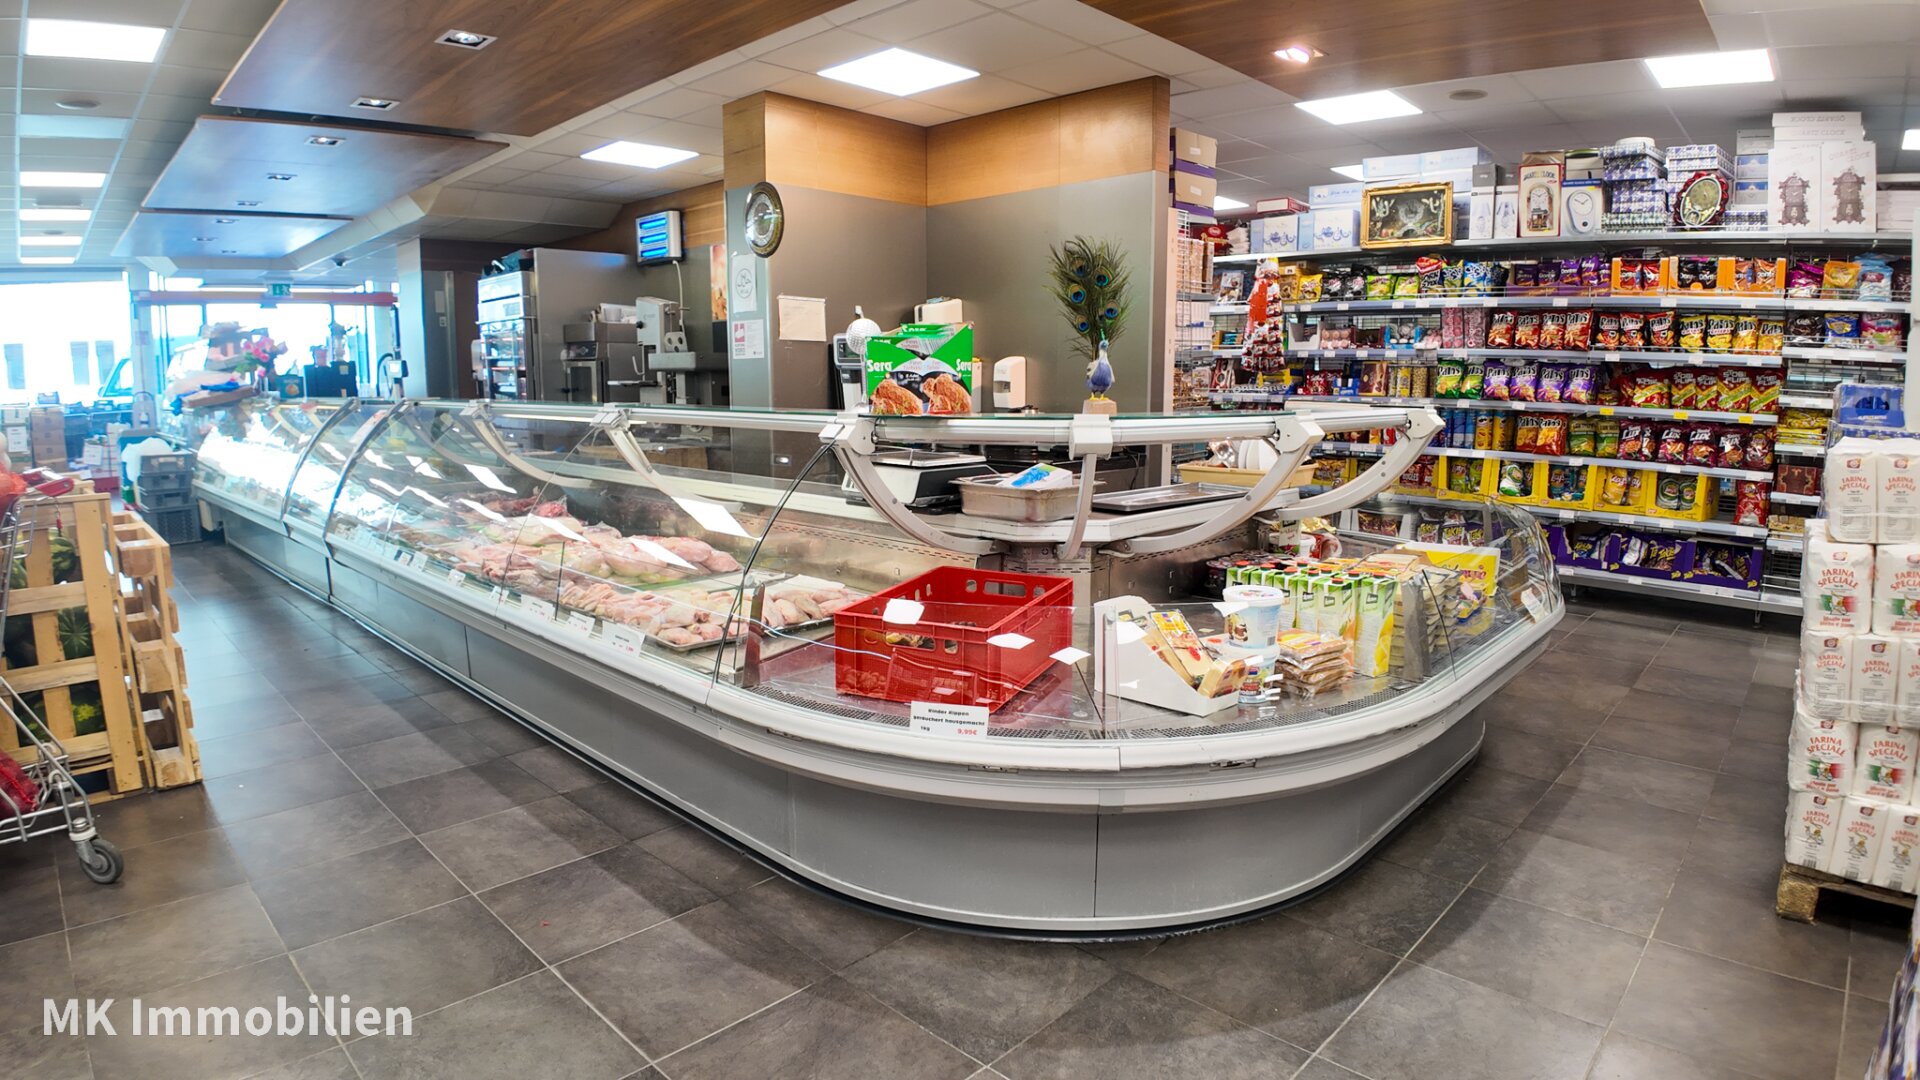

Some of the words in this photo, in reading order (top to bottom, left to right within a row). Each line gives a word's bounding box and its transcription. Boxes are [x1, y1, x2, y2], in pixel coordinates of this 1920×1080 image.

[867, 359, 893, 372] Sera
[1841, 476, 1868, 484] FARINA
[1888, 476, 1914, 484] FARINA
[1839, 482, 1871, 492] SPECIALE
[1885, 482, 1916, 492] SPECIALE
[1822, 568, 1855, 579] FARINA
[1894, 571, 1920, 580] FARIN
[1817, 576, 1859, 589] SPECIALE
[1890, 579, 1920, 591] SPECIA
[1816, 660, 1846, 669] SPECIALE
[1864, 660, 1890, 668] FARINA
[1861, 666, 1892, 675] SPECIALE
[1809, 736, 1843, 746] FARINA
[1873, 740, 1906, 751] FARINA
[1806, 744, 1847, 758] SPECIALE
[1868, 749, 1909, 762] SPECIALE
